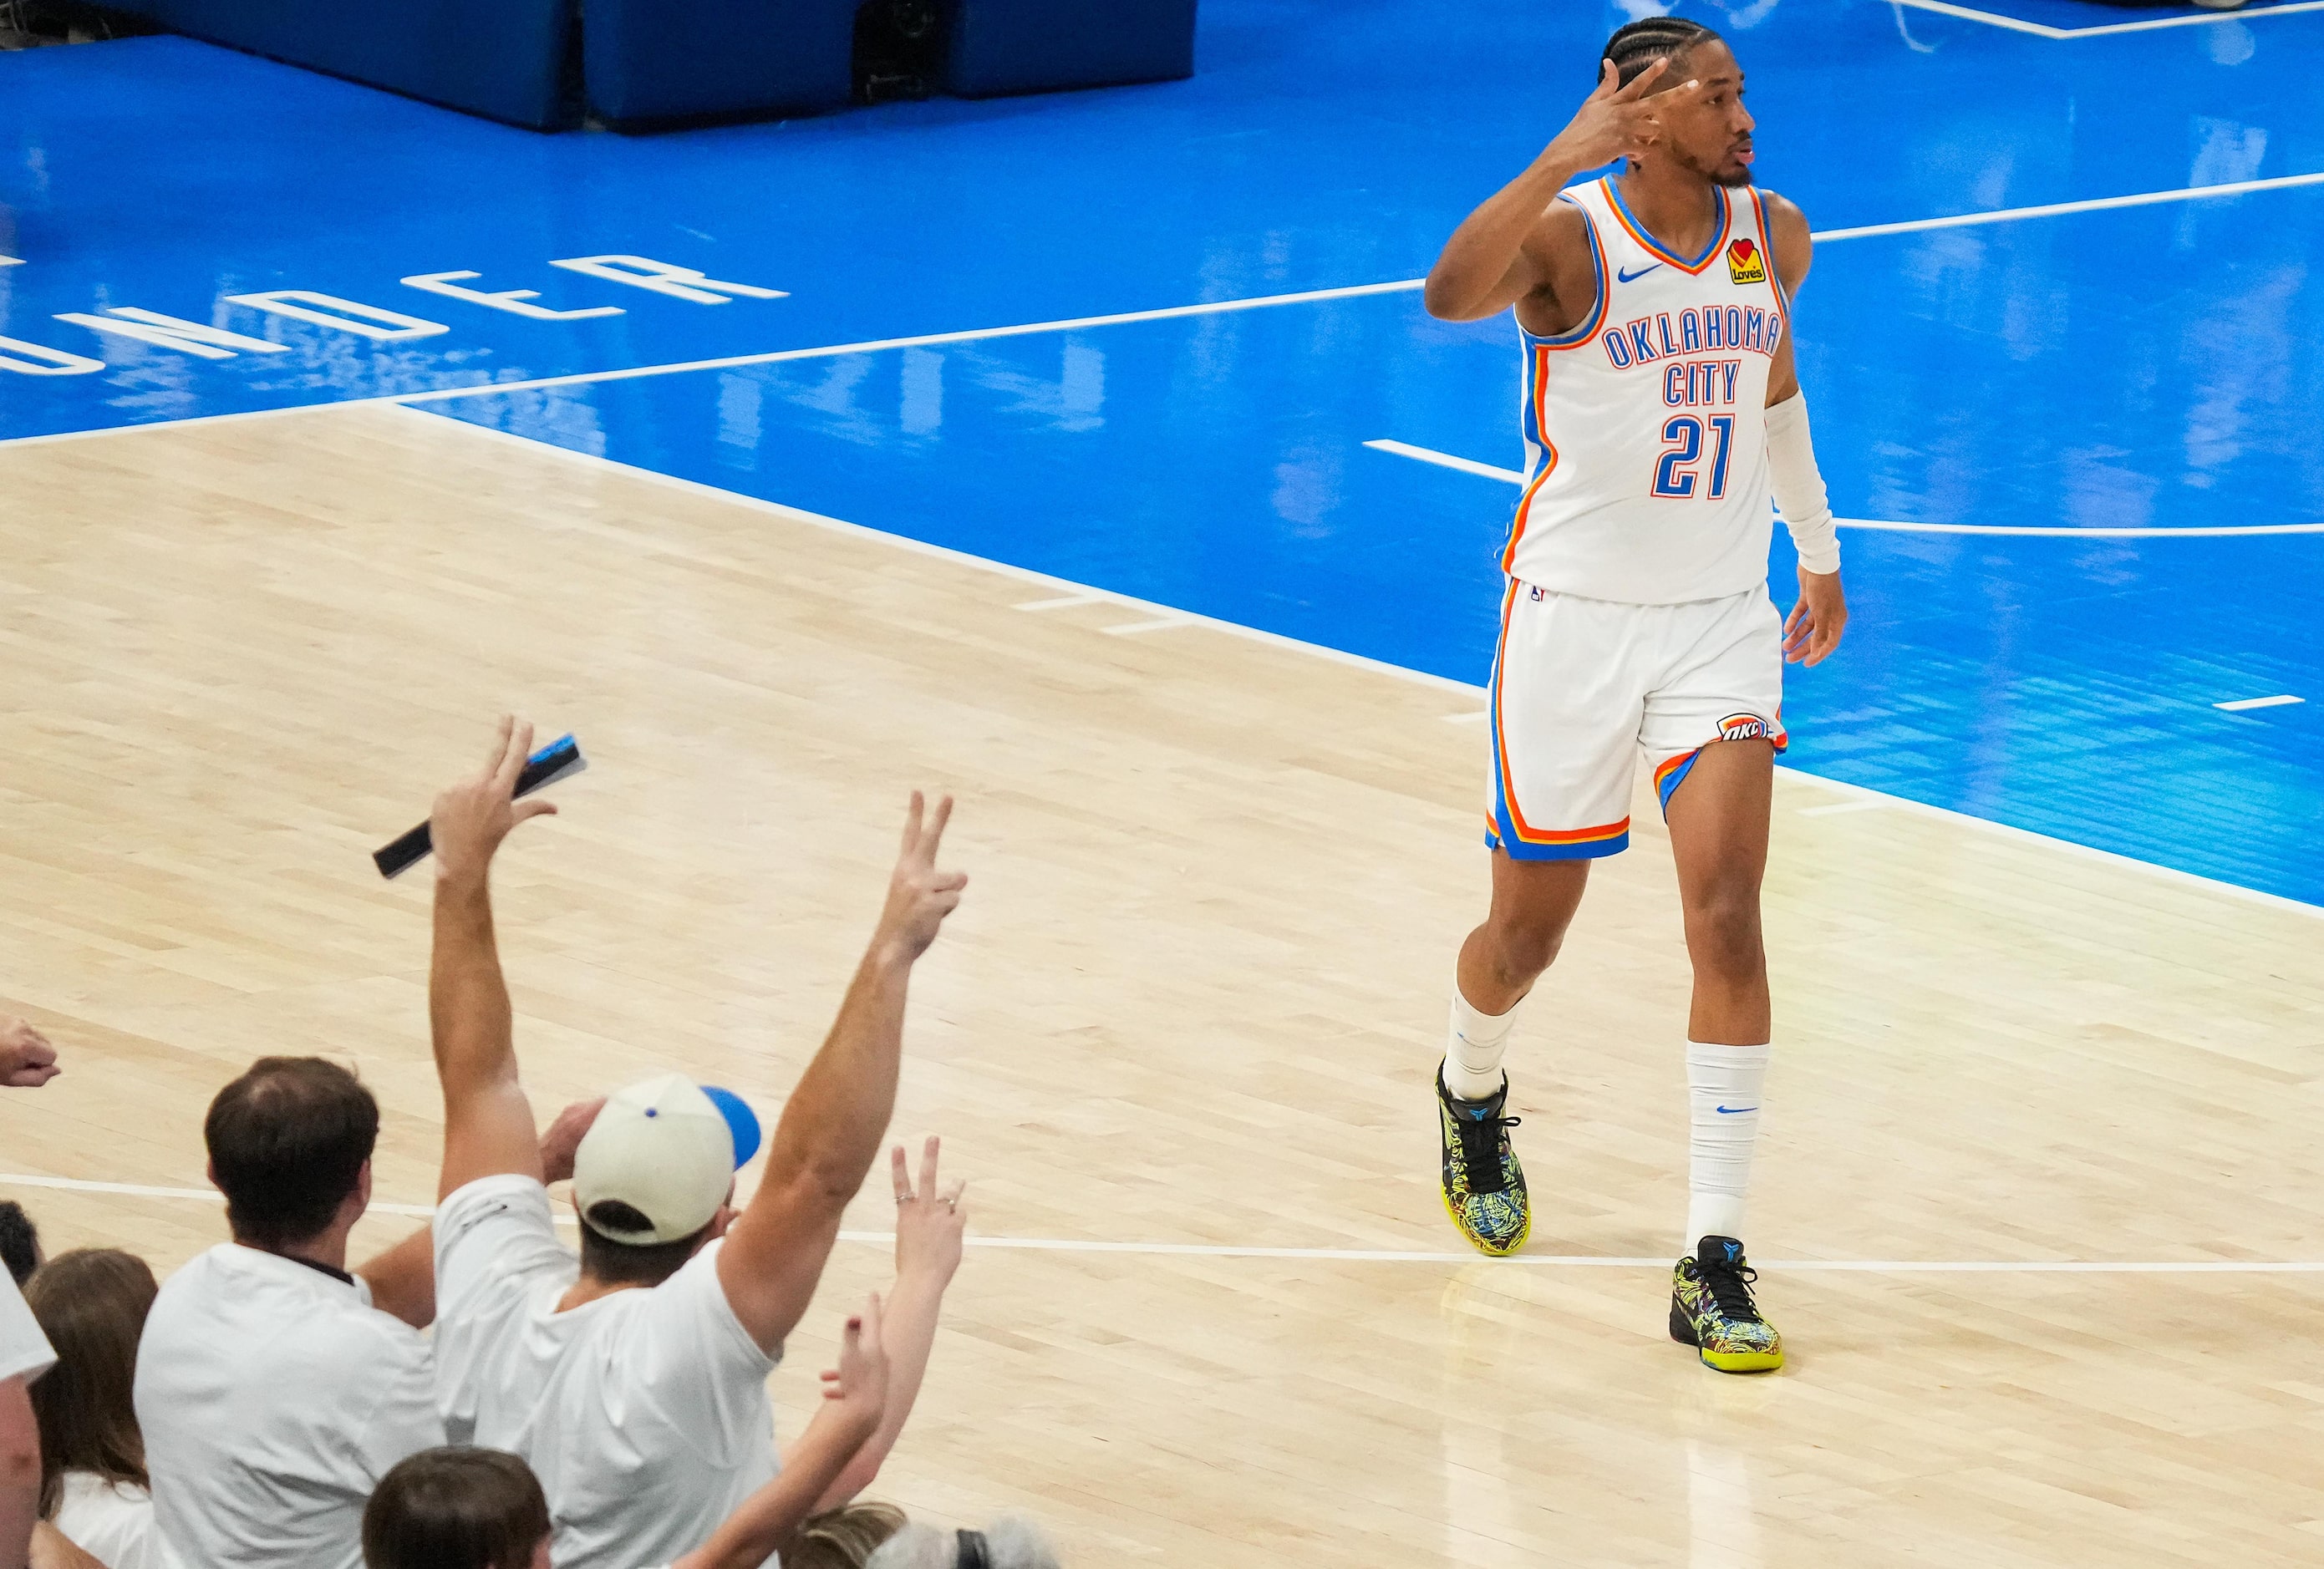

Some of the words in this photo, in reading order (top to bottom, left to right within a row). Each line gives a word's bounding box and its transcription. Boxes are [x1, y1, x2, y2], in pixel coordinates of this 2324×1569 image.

[1602, 305, 1783, 369] OKLAHOMA
[1663, 359, 1741, 407] CITY
[1650, 414, 1736, 500] 21
